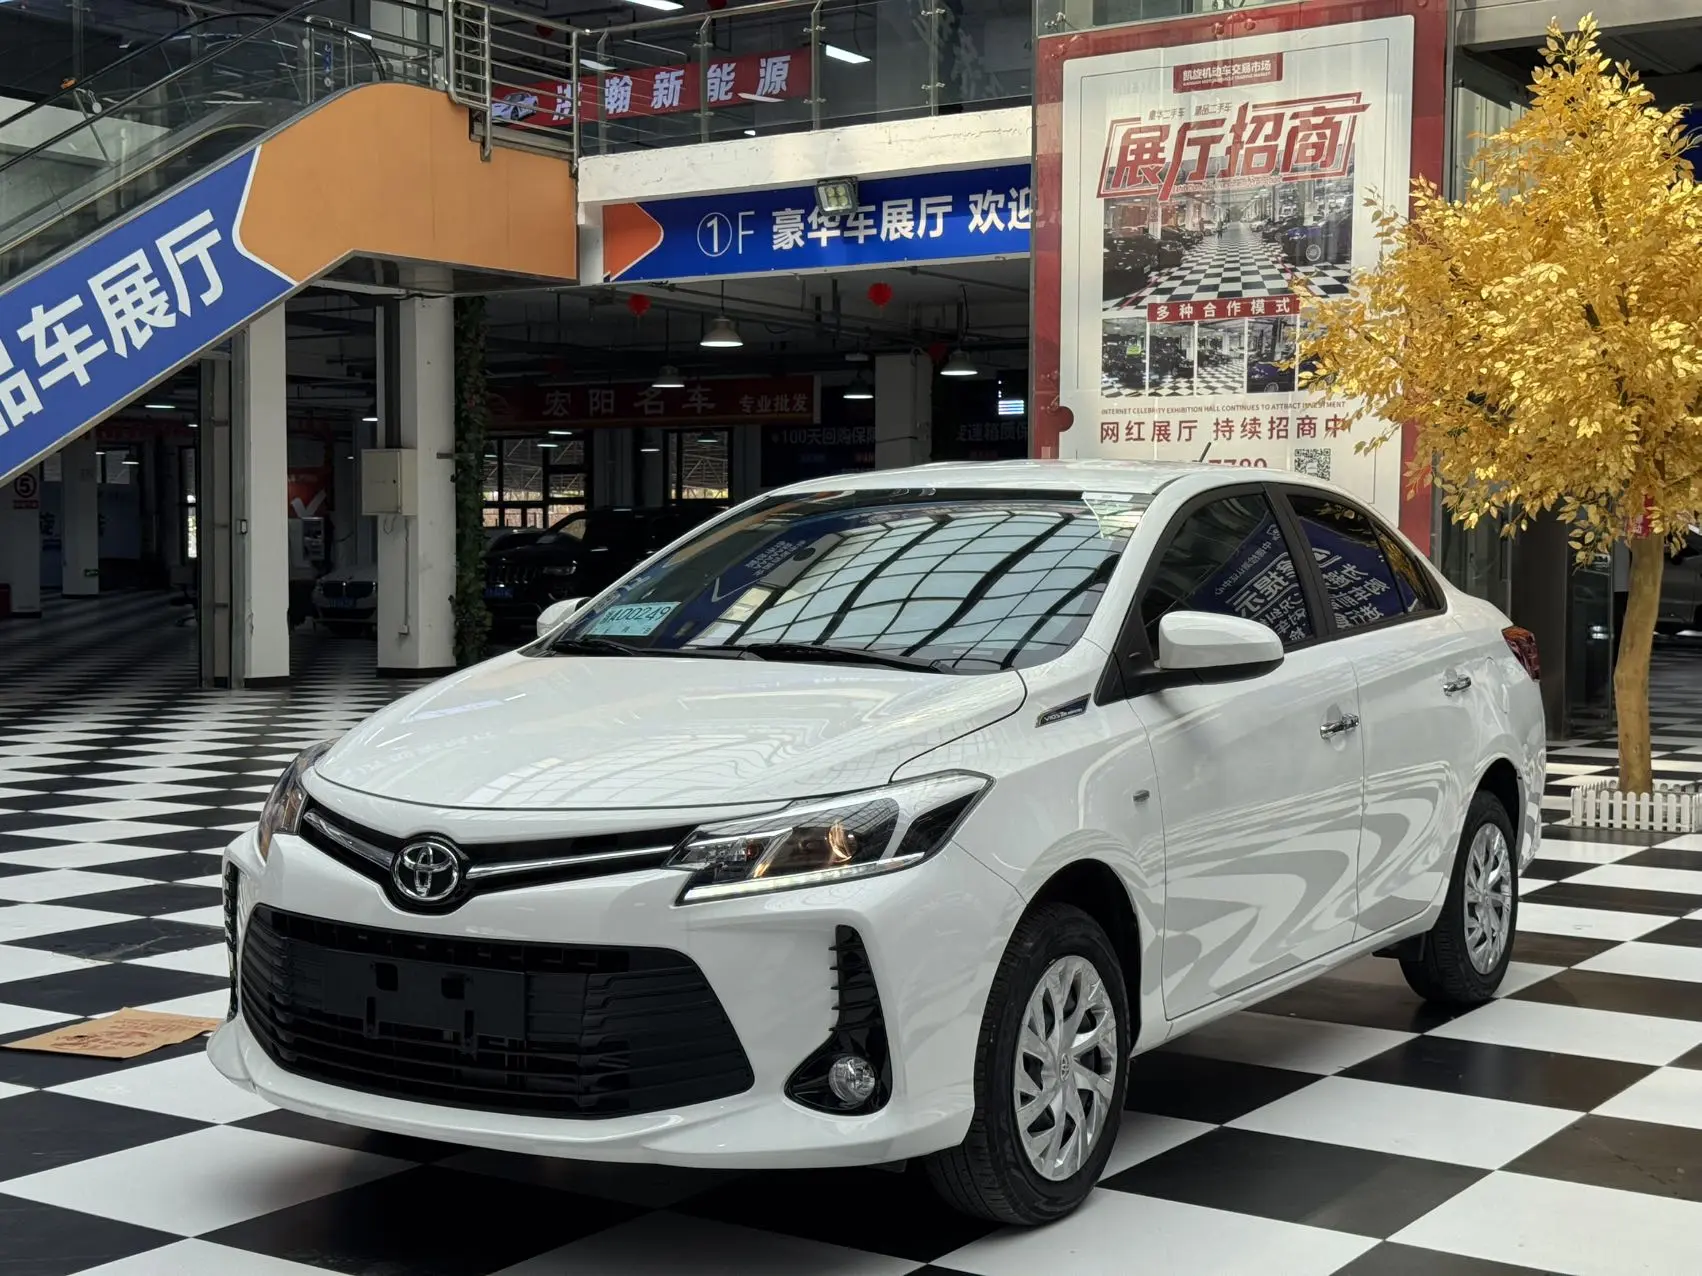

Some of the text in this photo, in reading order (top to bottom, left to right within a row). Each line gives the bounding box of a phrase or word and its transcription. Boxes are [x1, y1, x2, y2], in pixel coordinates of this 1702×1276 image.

[1111, 101, 1372, 201] 展厅招商
[771, 195, 953, 251] 豪华车展厅
[1156, 298, 1290, 321] 多种合作模式
[541, 384, 808, 418] 宏阳名车 专业批发
[1101, 407, 1131, 415] INTERNET
[1132, 407, 1166, 415] CELEBRITY
[1166, 405, 1201, 414] EXHIBITION
[1203, 404, 1221, 413] HALL
[1221, 404, 1260, 412] CONTINUES
[1261, 403, 1271, 411] TO
[1271, 402, 1300, 410] ATTRACT
[1100, 413, 1345, 444] 网红展厅 持续招商中
